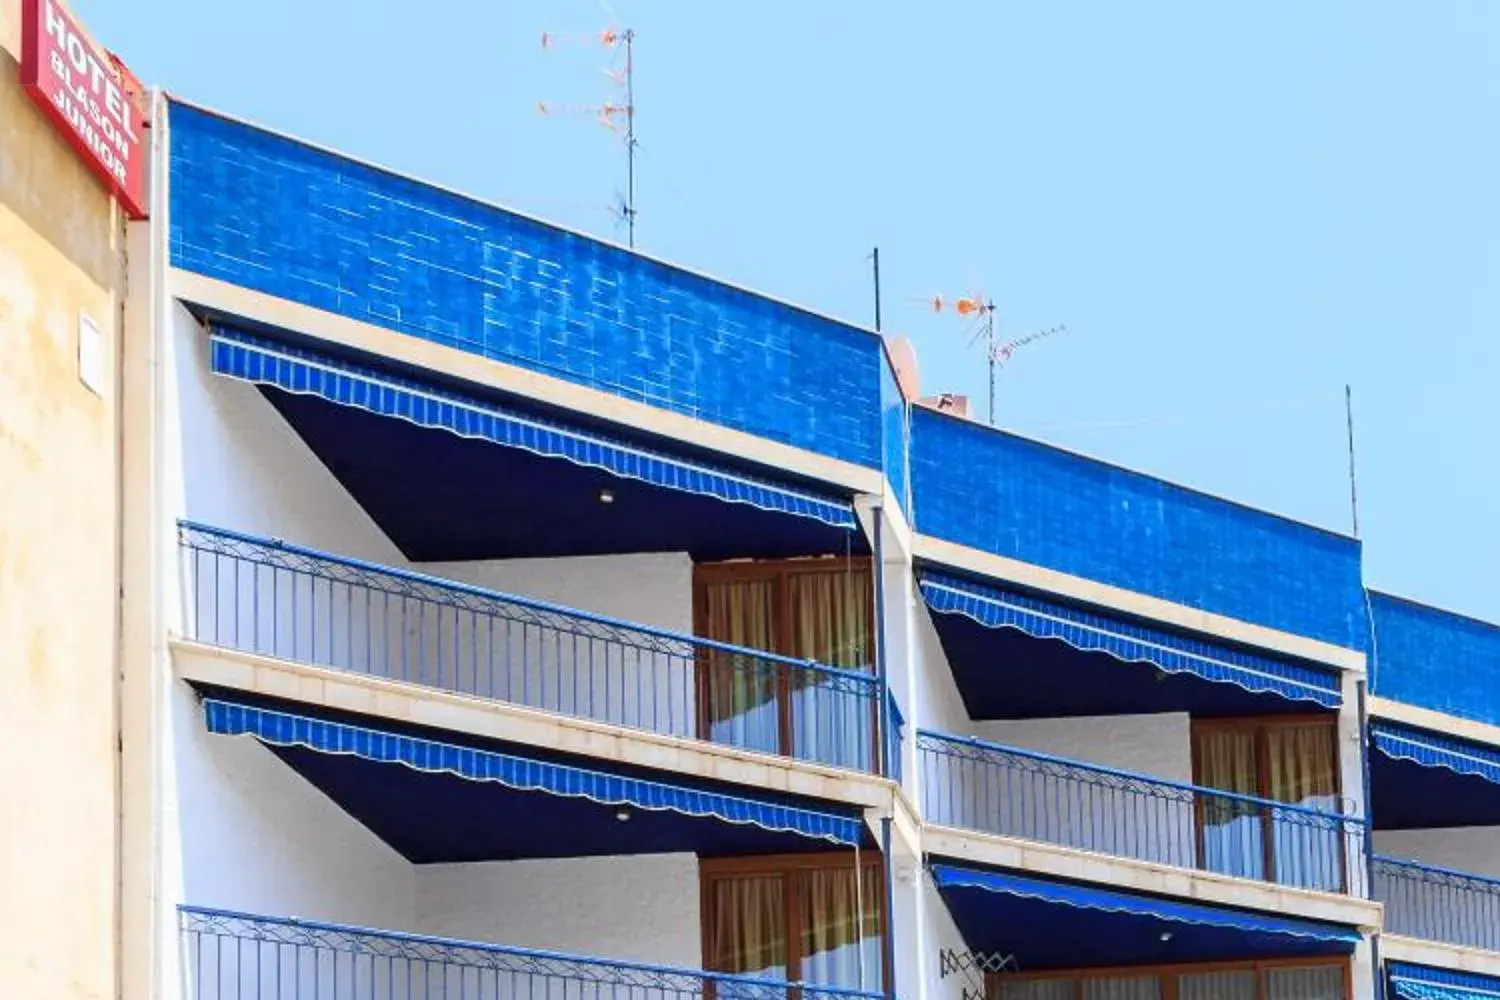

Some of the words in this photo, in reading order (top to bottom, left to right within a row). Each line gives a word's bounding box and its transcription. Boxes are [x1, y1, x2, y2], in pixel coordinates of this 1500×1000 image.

[45, 0, 139, 144] HOTEL
[50, 50, 129, 160] BLASON
[53, 88, 127, 186] JUNIOR
